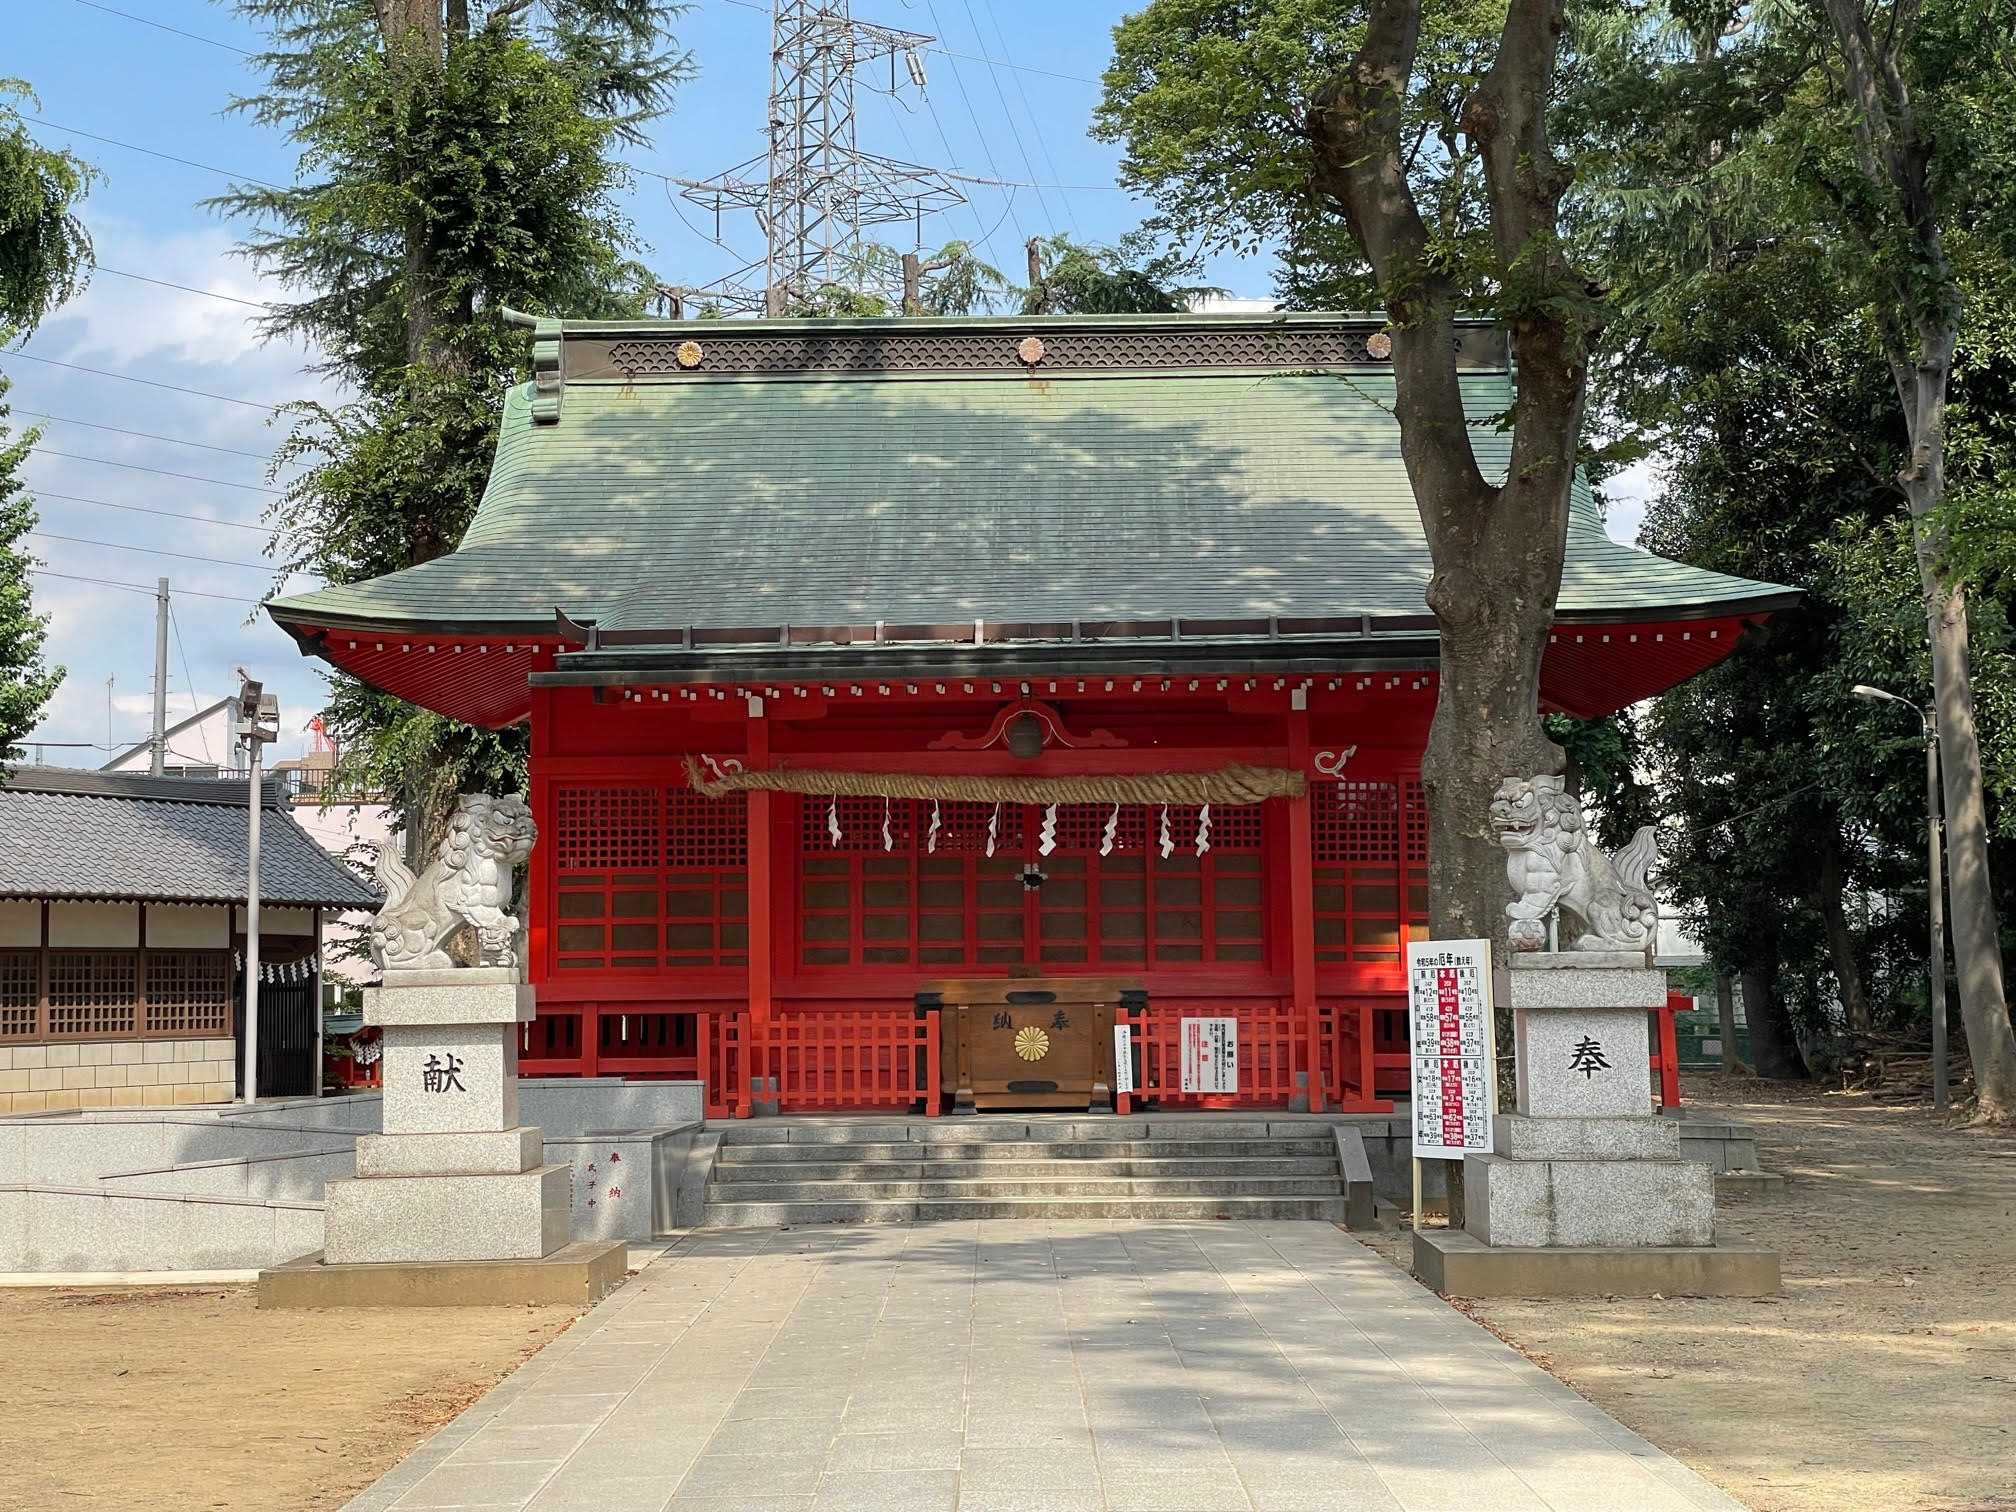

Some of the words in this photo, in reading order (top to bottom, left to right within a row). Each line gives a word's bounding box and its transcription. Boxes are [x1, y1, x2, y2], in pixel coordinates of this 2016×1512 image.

[423, 1053, 466, 1093] 献
[1568, 1035, 1612, 1079] 奉
[587, 1162, 597, 1208] 氏子中
[609, 1152, 621, 1199] 奉納
